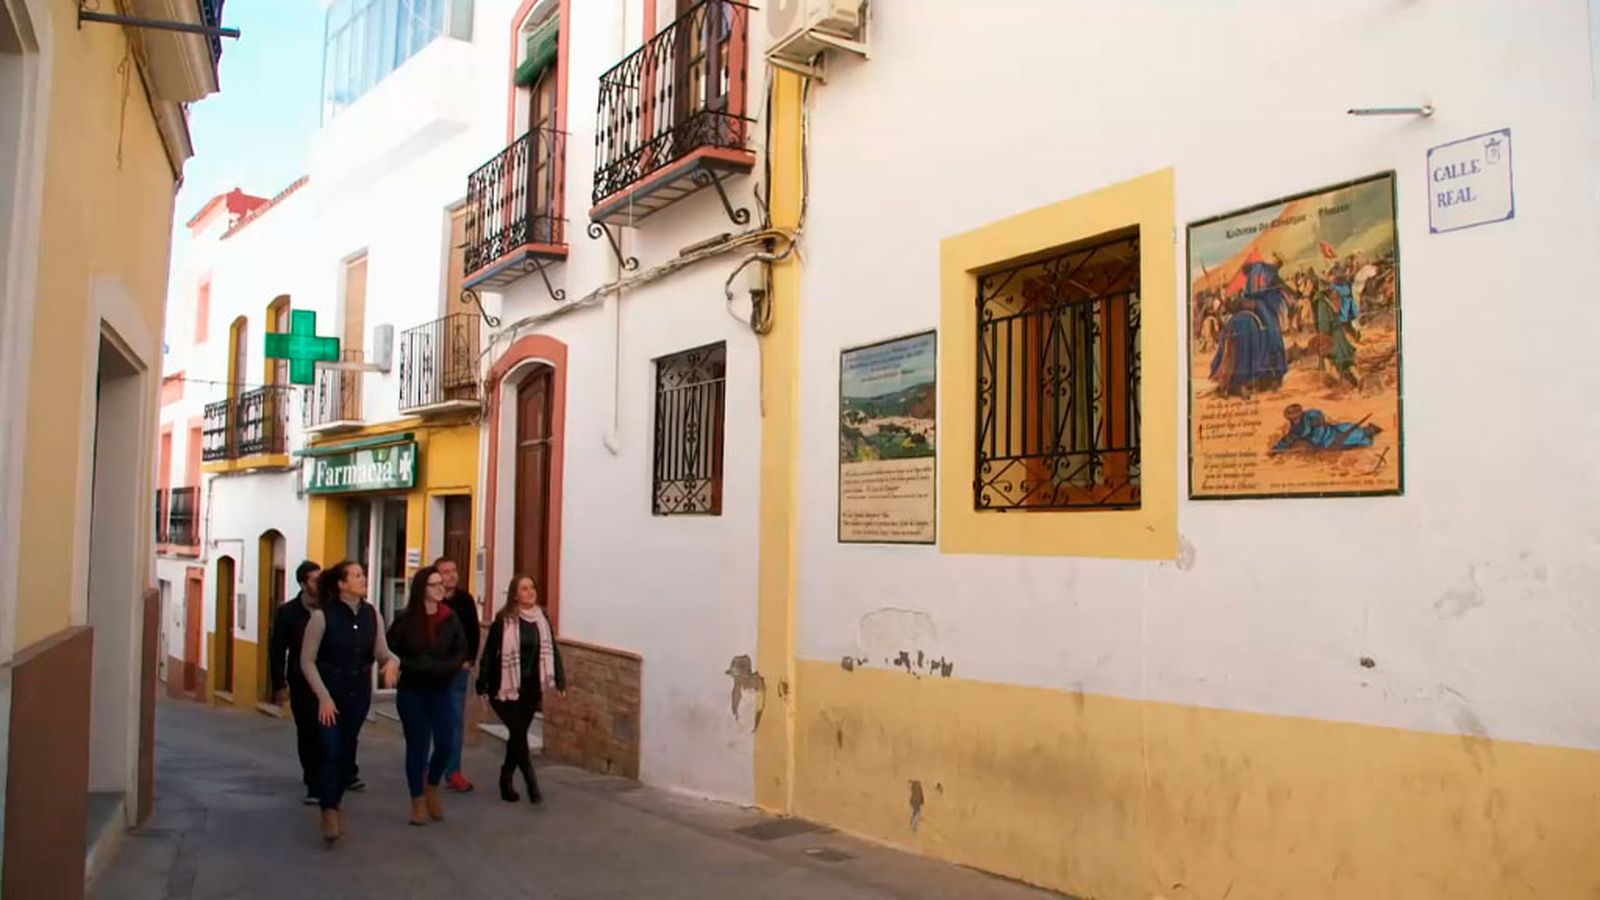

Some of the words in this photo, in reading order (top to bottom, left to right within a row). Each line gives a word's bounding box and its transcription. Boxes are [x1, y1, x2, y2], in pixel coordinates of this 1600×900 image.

[1434, 159, 1481, 182] CALLE
[1437, 187, 1477, 208] REAL
[316, 460, 393, 488] Farmacia
